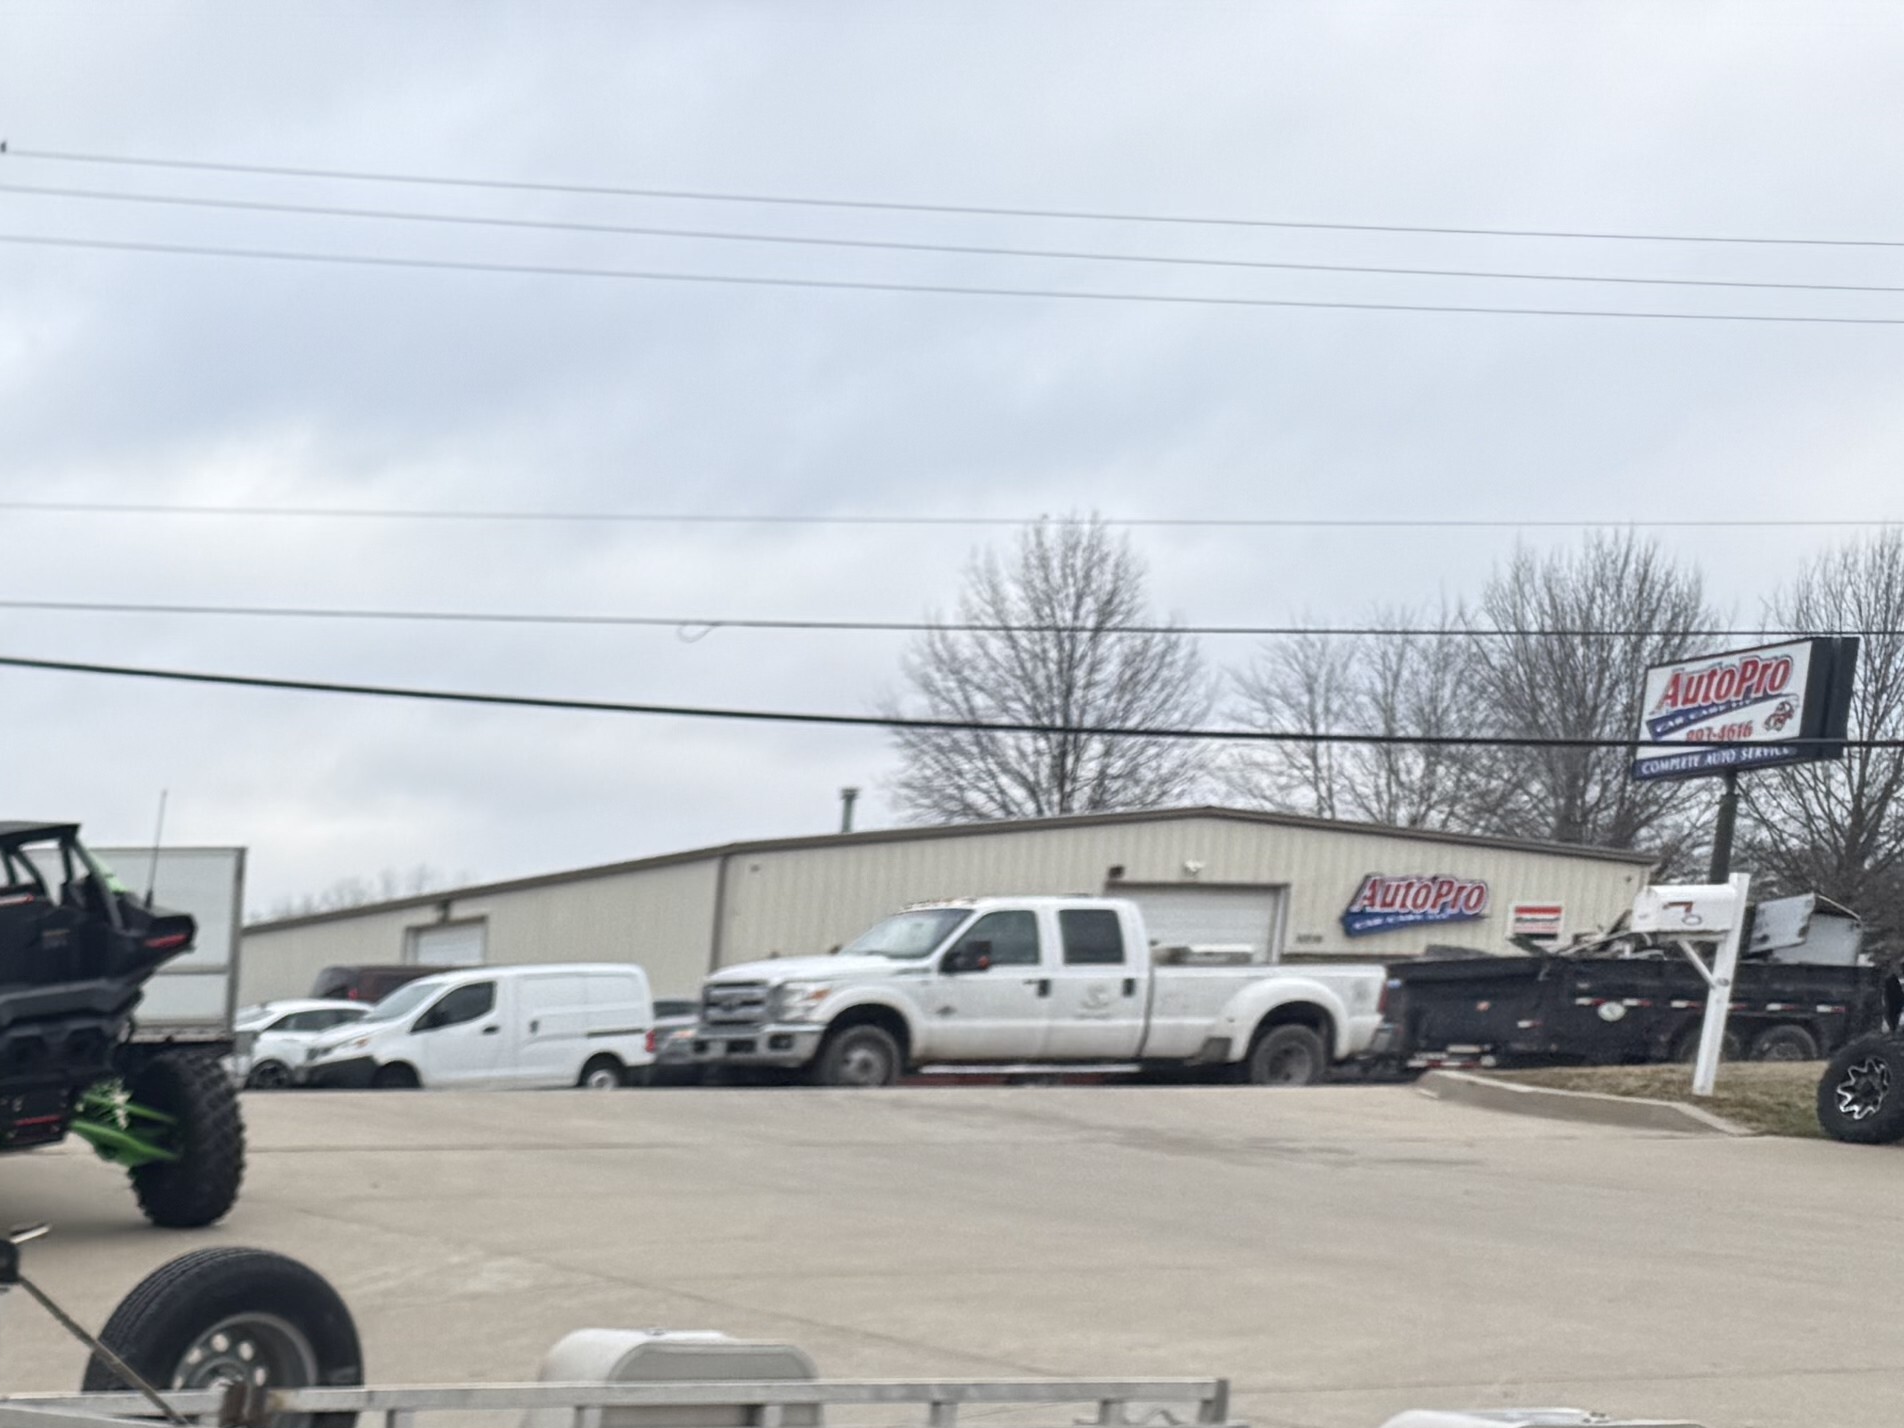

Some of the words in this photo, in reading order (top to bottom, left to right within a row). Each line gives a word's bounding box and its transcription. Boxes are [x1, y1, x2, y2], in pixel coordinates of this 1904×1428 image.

[1652, 655, 1794, 712] AutoPro
[1642, 756, 1702, 774] COMPLETE
[1703, 750, 1737, 767] AUTO
[1356, 877, 1487, 915] AutoPro
